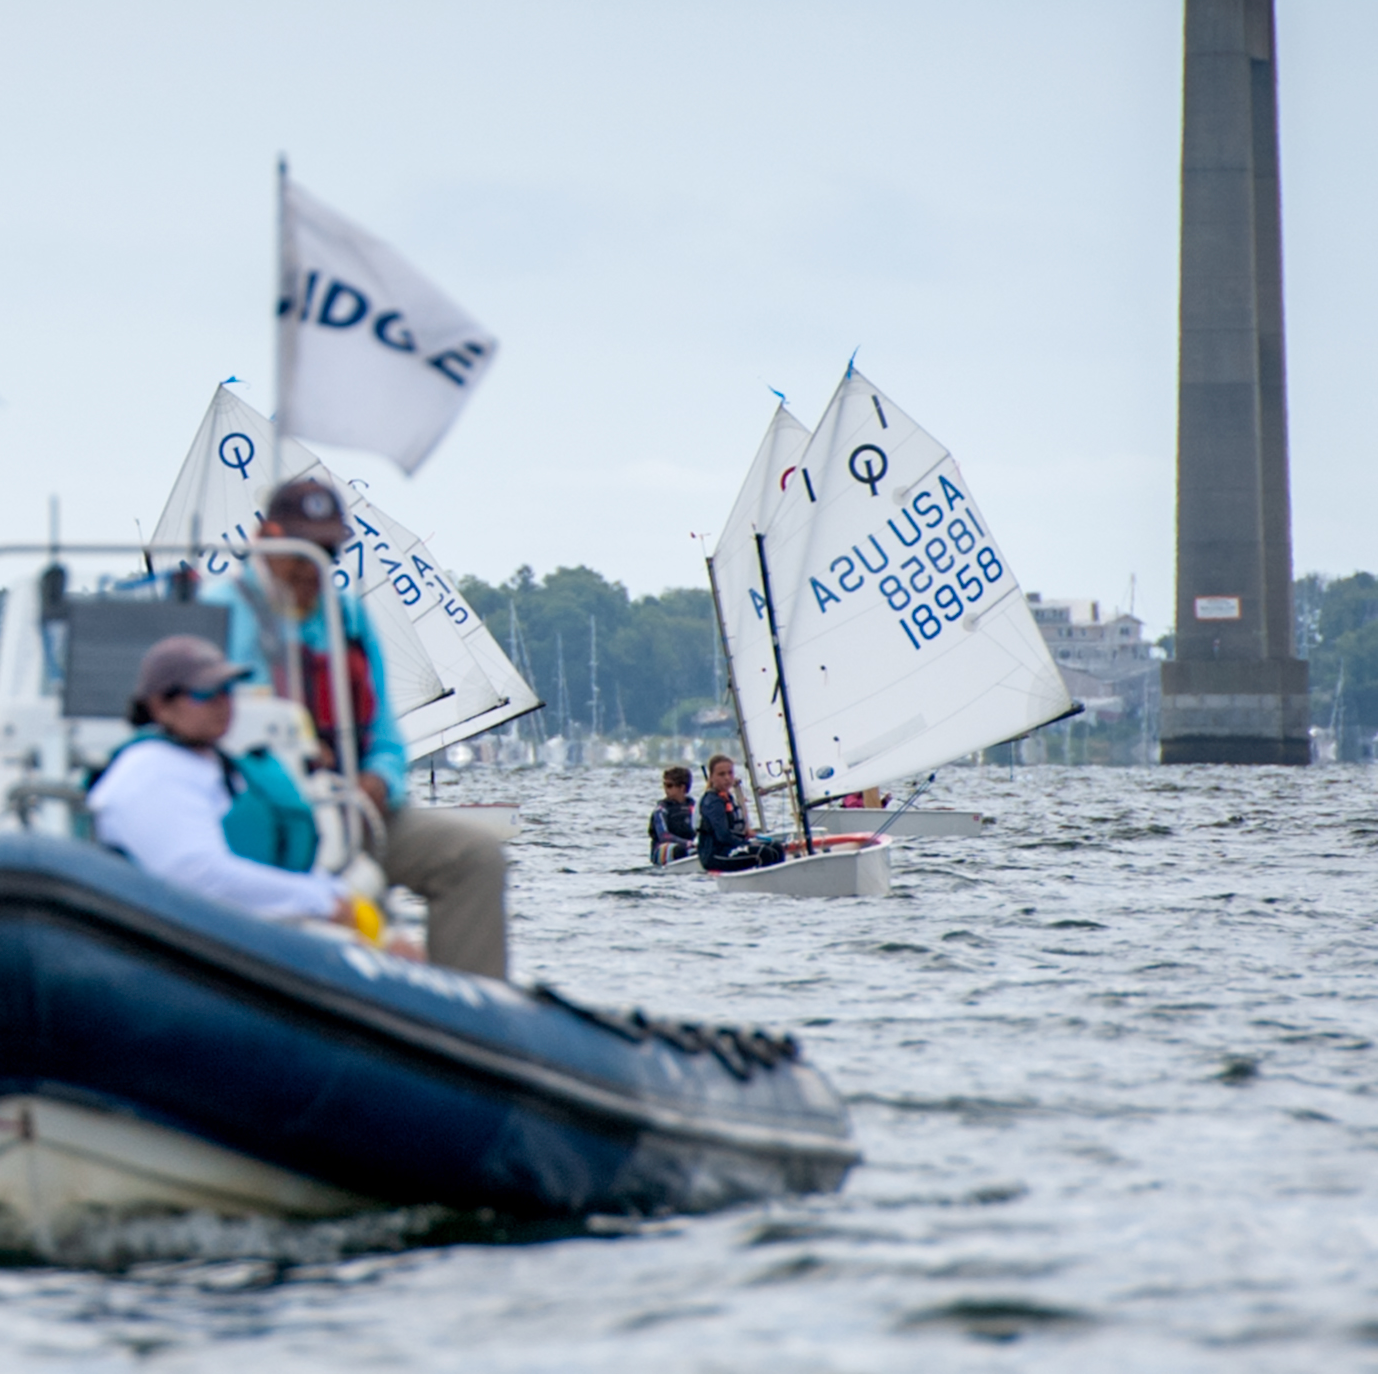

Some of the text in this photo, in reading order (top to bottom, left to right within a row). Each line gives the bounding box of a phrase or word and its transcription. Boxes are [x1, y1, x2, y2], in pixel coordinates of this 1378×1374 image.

[277, 270, 484, 387] IDGE
[887, 475, 965, 547] USA
[899, 546, 1003, 650] 18958
